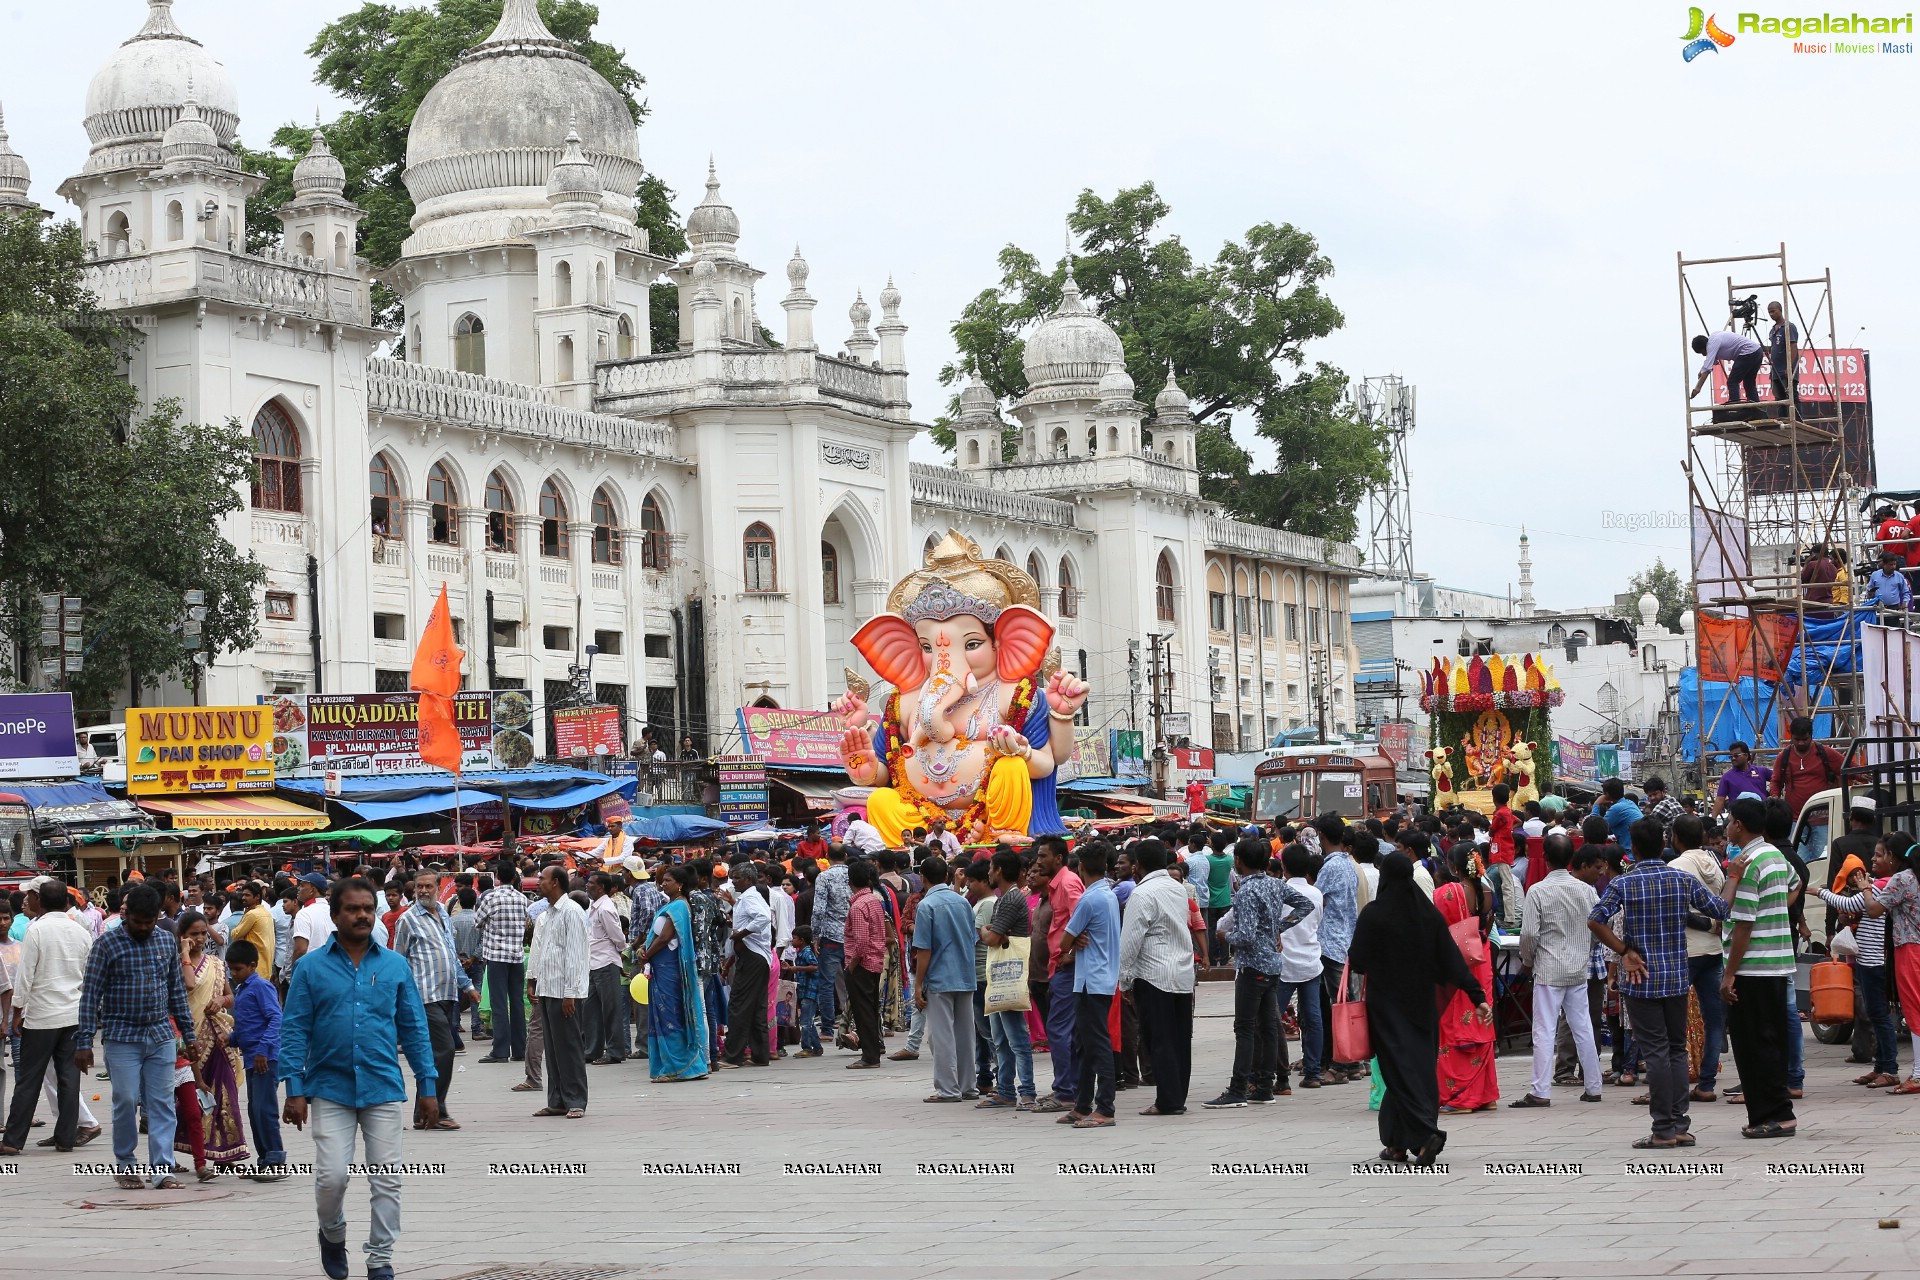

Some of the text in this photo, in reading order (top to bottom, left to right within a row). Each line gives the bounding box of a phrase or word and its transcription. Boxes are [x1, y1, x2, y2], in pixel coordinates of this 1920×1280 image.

[1812, 356, 1858, 374] ARTS
[1844, 383, 1865, 396] 123
[311, 700, 488, 728] MUQADDAR TEL
[140, 711, 262, 740] MUNNU
[311, 730, 354, 742] KALYANI
[160, 745, 245, 762] PAN SHOP
[326, 744, 344, 752] SPL.
[1328, 757, 1354, 766] CARRIER
[178, 818, 212, 826] MUNNU
[216, 818, 233, 826] PAN
[236, 818, 260, 826] SHOP
[263, 818, 270, 826] &
